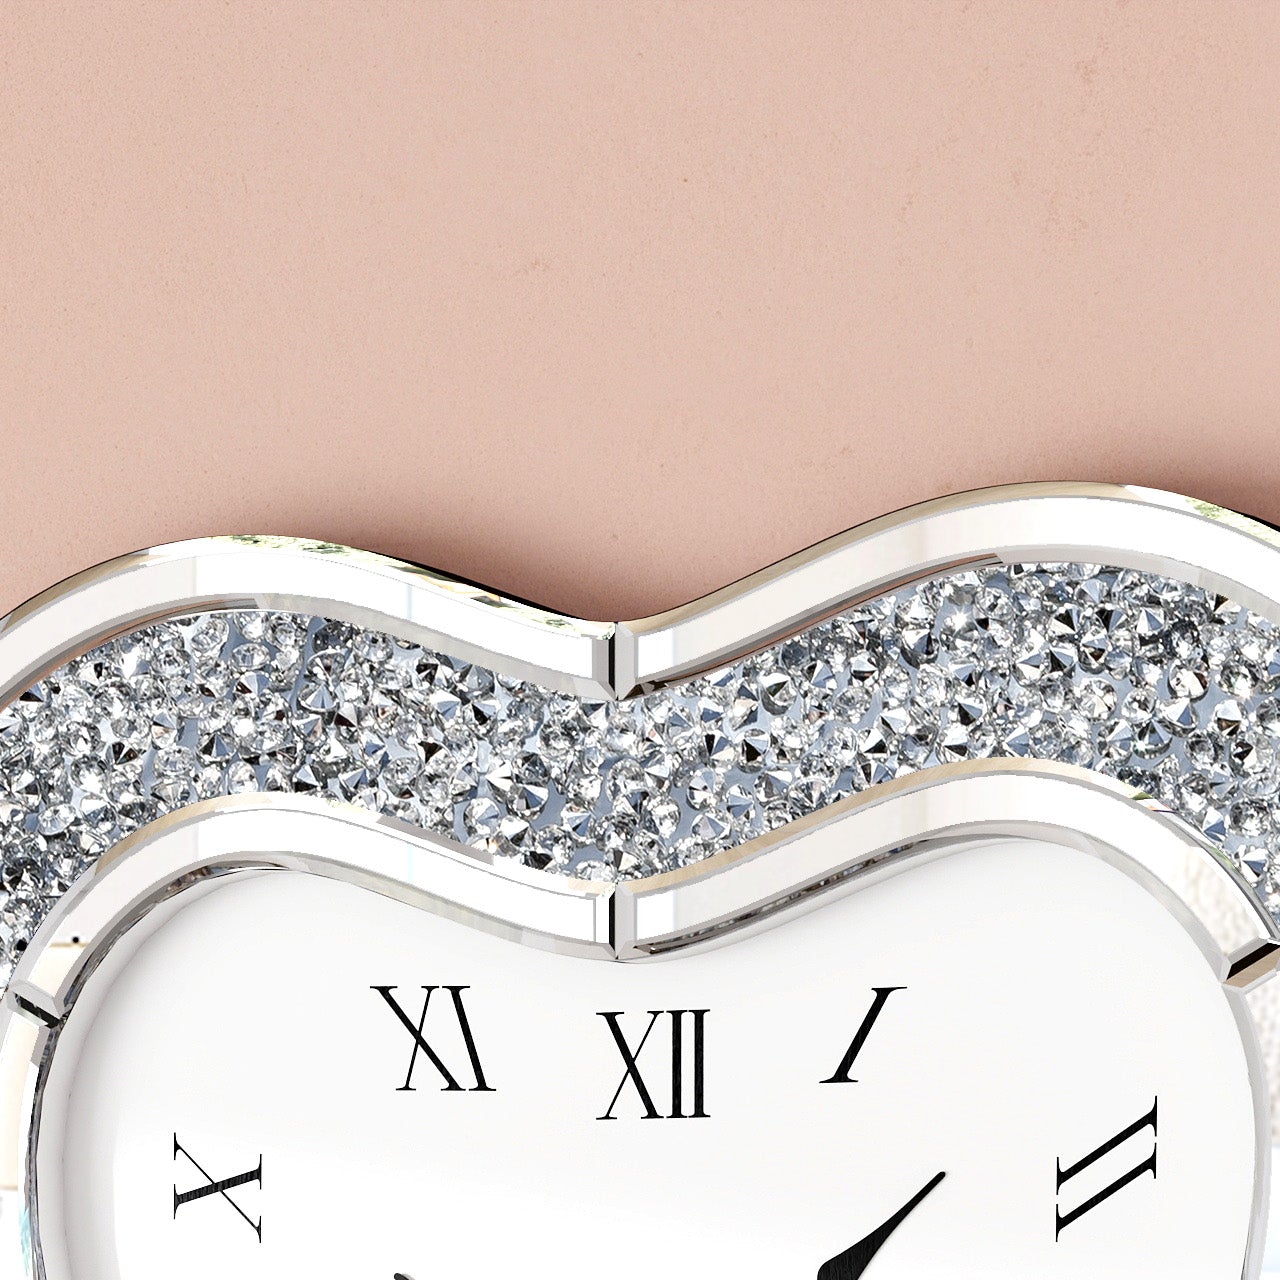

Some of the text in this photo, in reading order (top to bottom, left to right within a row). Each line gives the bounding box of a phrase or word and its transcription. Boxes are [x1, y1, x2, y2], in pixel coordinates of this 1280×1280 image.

[370, 986, 496, 1091] XI
[596, 1009, 710, 1120] XII
[819, 986, 907, 1083] I
[174, 1132, 262, 1243] X
[1056, 1096, 1157, 1242] II
